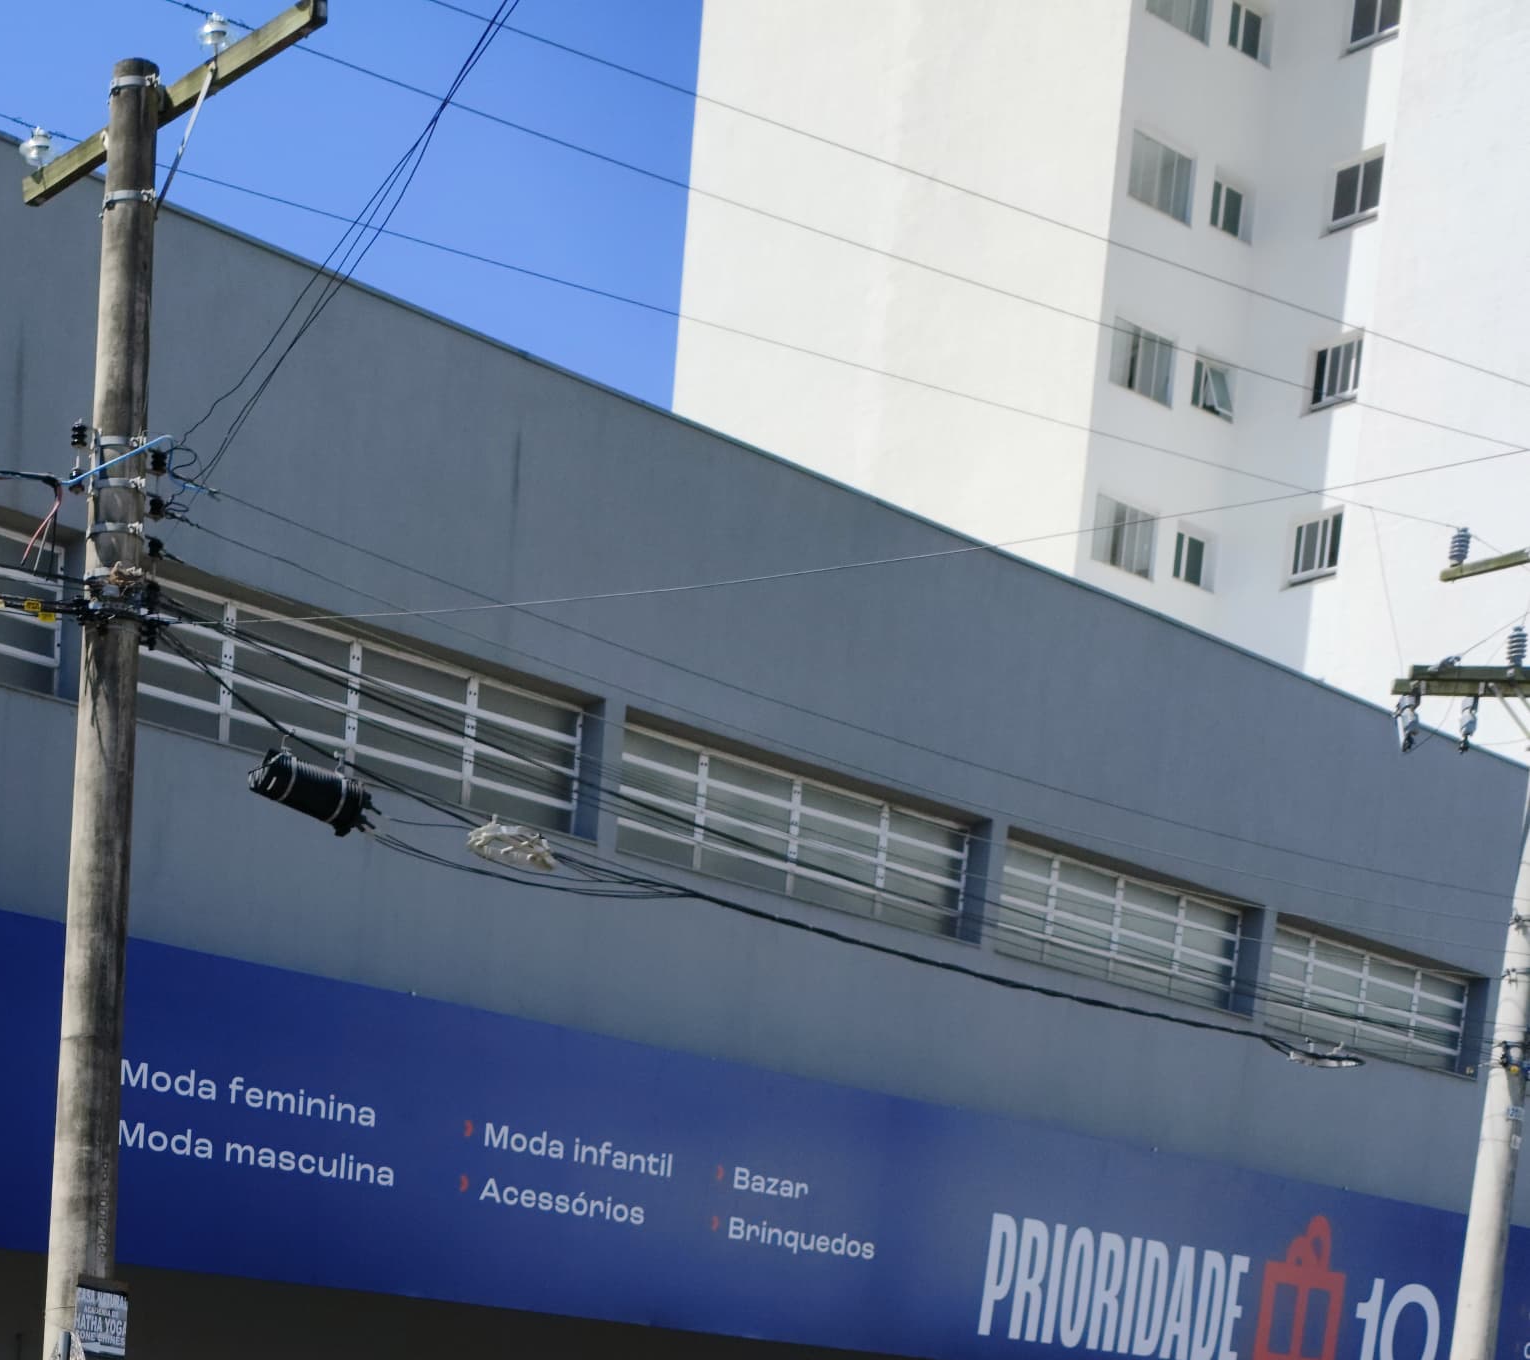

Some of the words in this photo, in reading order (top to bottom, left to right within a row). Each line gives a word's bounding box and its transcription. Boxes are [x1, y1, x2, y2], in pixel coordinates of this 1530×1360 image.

[120, 1057, 217, 1103] Moda
[228, 1075, 378, 1129] feminina
[118, 1118, 214, 1162] Moda
[224, 1138, 396, 1187] masculina
[484, 1123, 566, 1162] Moda
[573, 1135, 674, 1178] infantil
[478, 1178, 645, 1226] Acessórios
[733, 1165, 810, 1201] Bazar
[727, 1215, 877, 1260] Brinquedos
